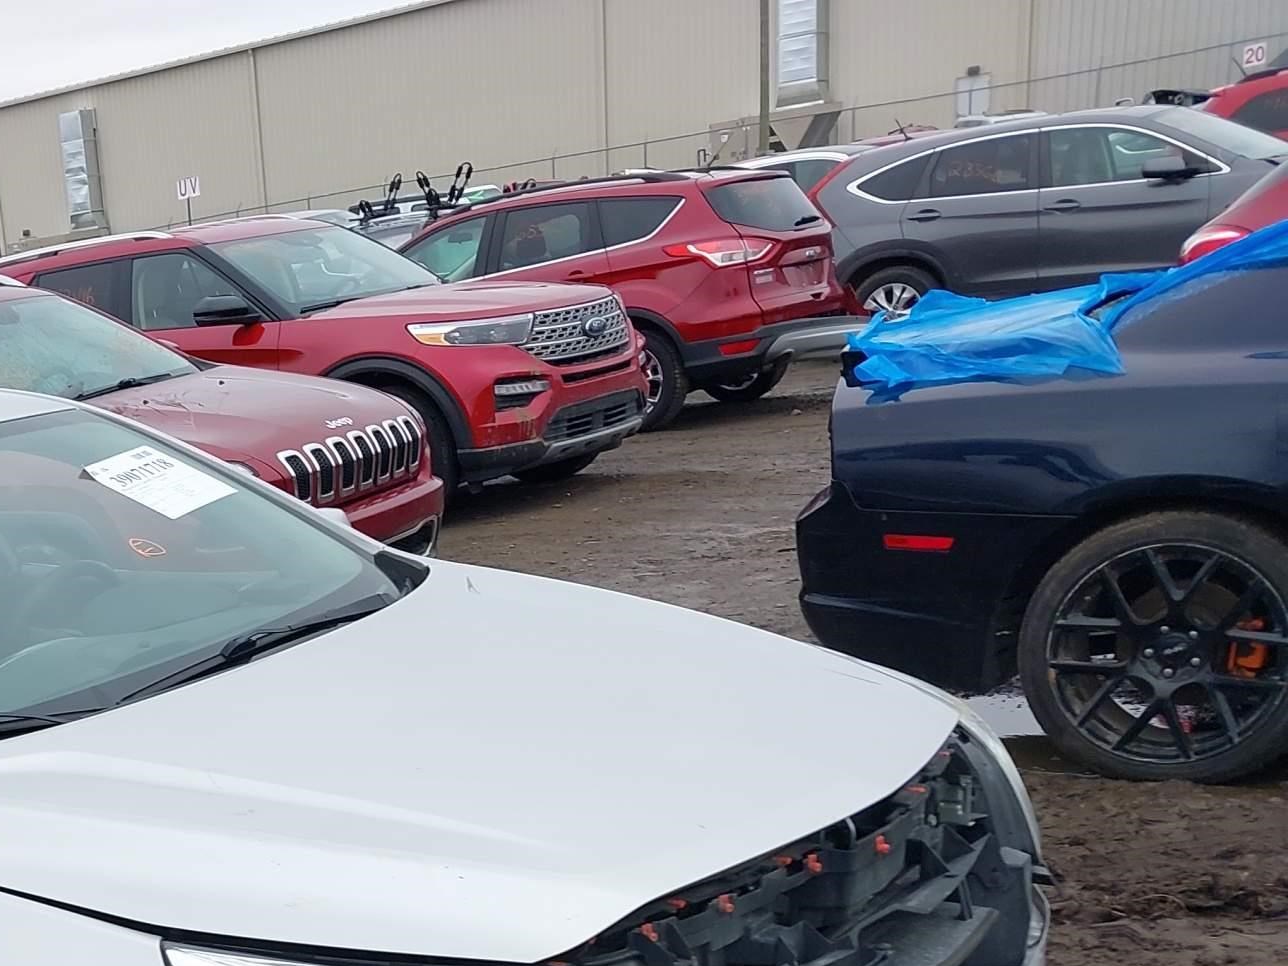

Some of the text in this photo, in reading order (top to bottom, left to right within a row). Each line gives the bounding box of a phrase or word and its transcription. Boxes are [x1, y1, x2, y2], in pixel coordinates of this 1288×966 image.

[1245, 46, 1265, 65] 20
[179, 176, 197, 197] UV
[324, 416, 353, 429] Jeep
[109, 458, 175, 488] 39071718
